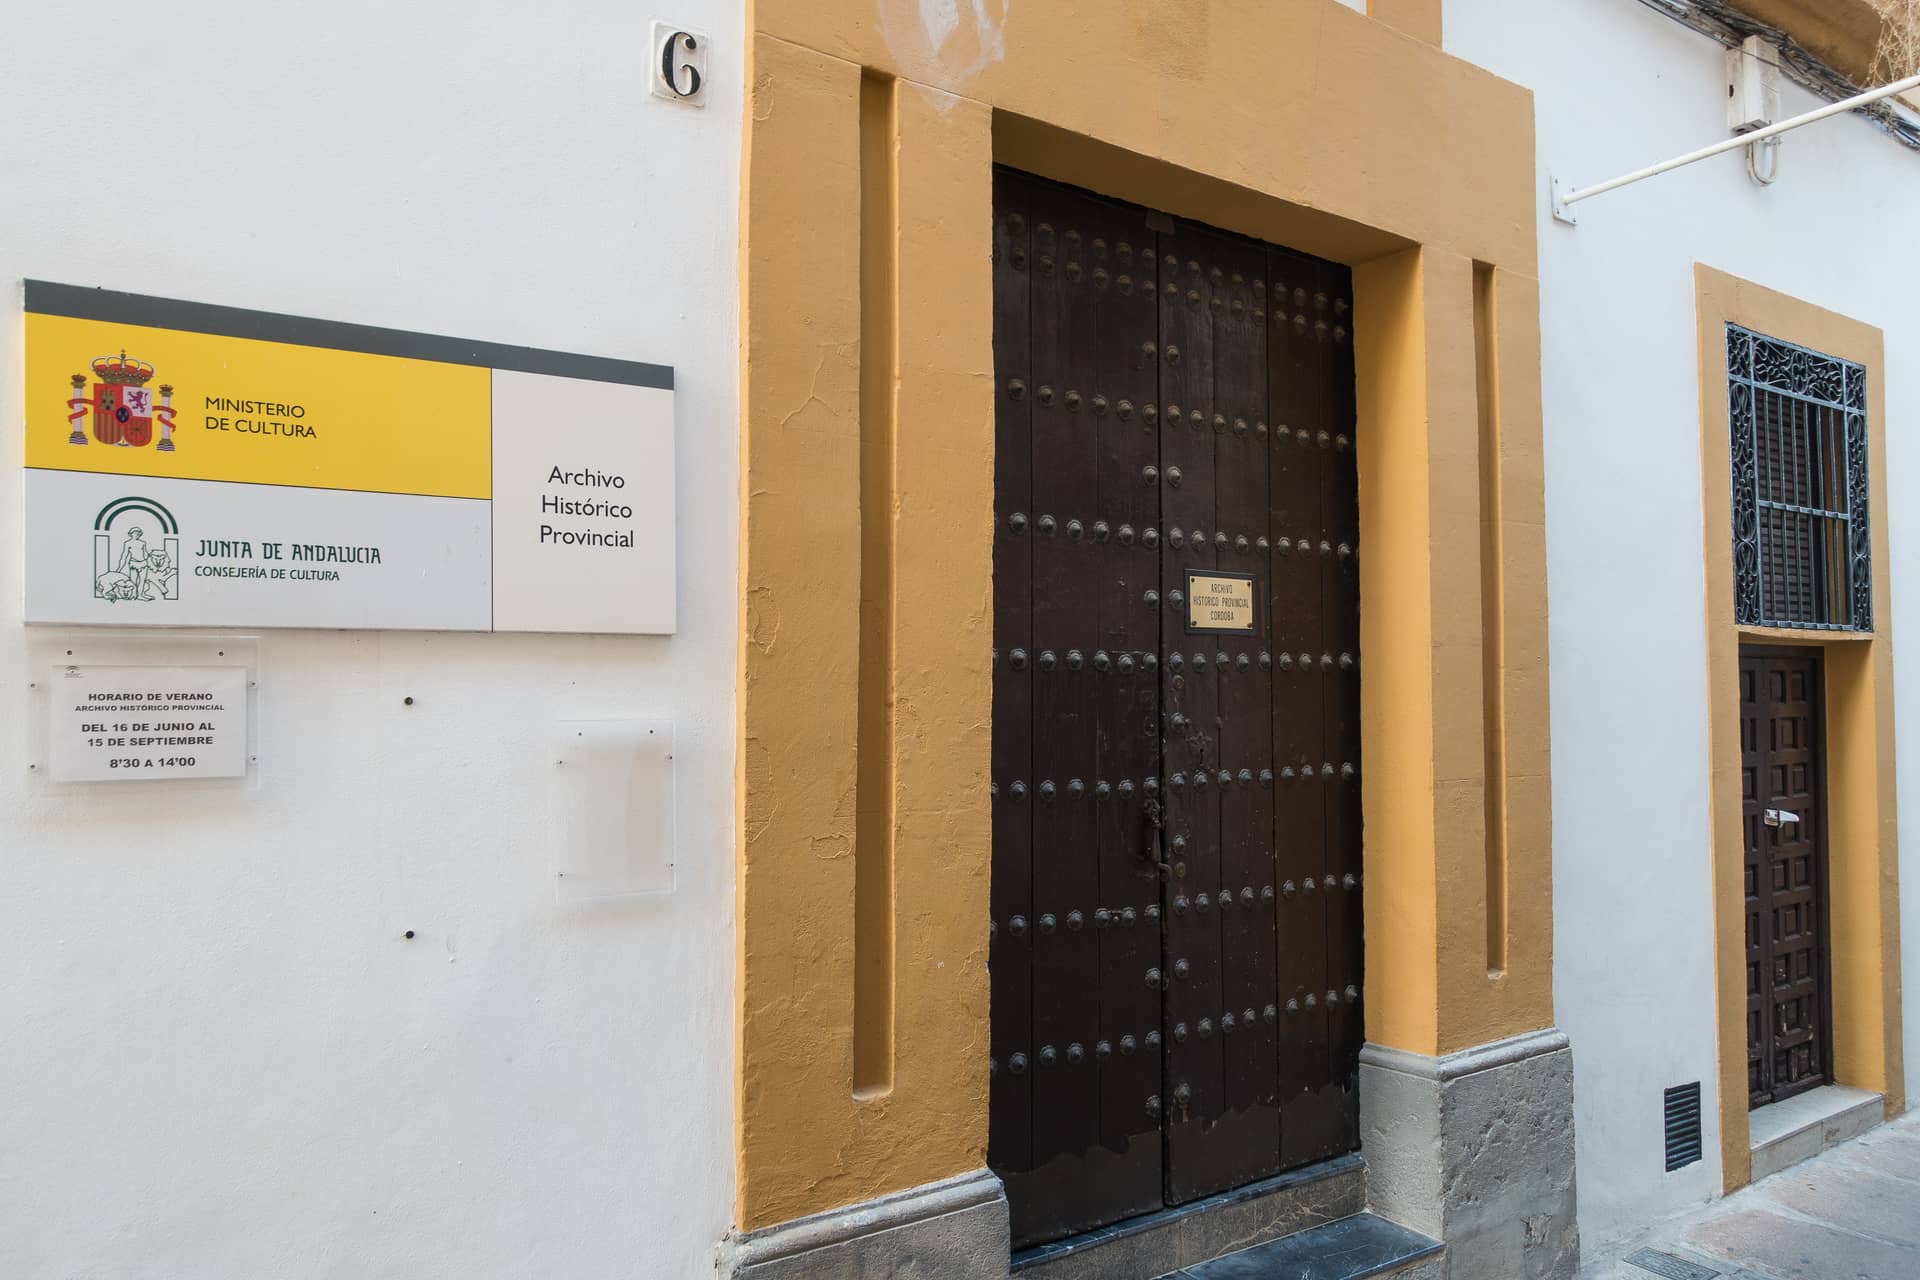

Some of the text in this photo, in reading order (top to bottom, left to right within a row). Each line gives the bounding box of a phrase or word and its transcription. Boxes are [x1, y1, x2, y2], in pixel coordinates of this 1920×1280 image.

[662, 31, 701, 97] 6
[205, 396, 305, 418] MINISTERIO
[205, 416, 317, 439] DE CULTURA
[548, 465, 625, 489] Archivo
[542, 494, 632, 519] Histórico
[540, 525, 634, 548] Provincial
[195, 539, 253, 559] JUNTA
[262, 542, 283, 560] DE
[194, 565, 340, 581] CONSEJERÍA DE CULTURA
[1210, 584, 1233, 594] ARCHIVO
[1222, 597, 1249, 609] PROVINCIAL
[88, 693, 213, 701] HORARIO DE VERANO
[120, 703, 170, 712] HISTÓRICO
[81, 722, 215, 732] DEL 16 DE JUNIO AL
[88, 736, 214, 747] 15 DE SEPTIEMBRE
[144, 759, 153, 768] A
